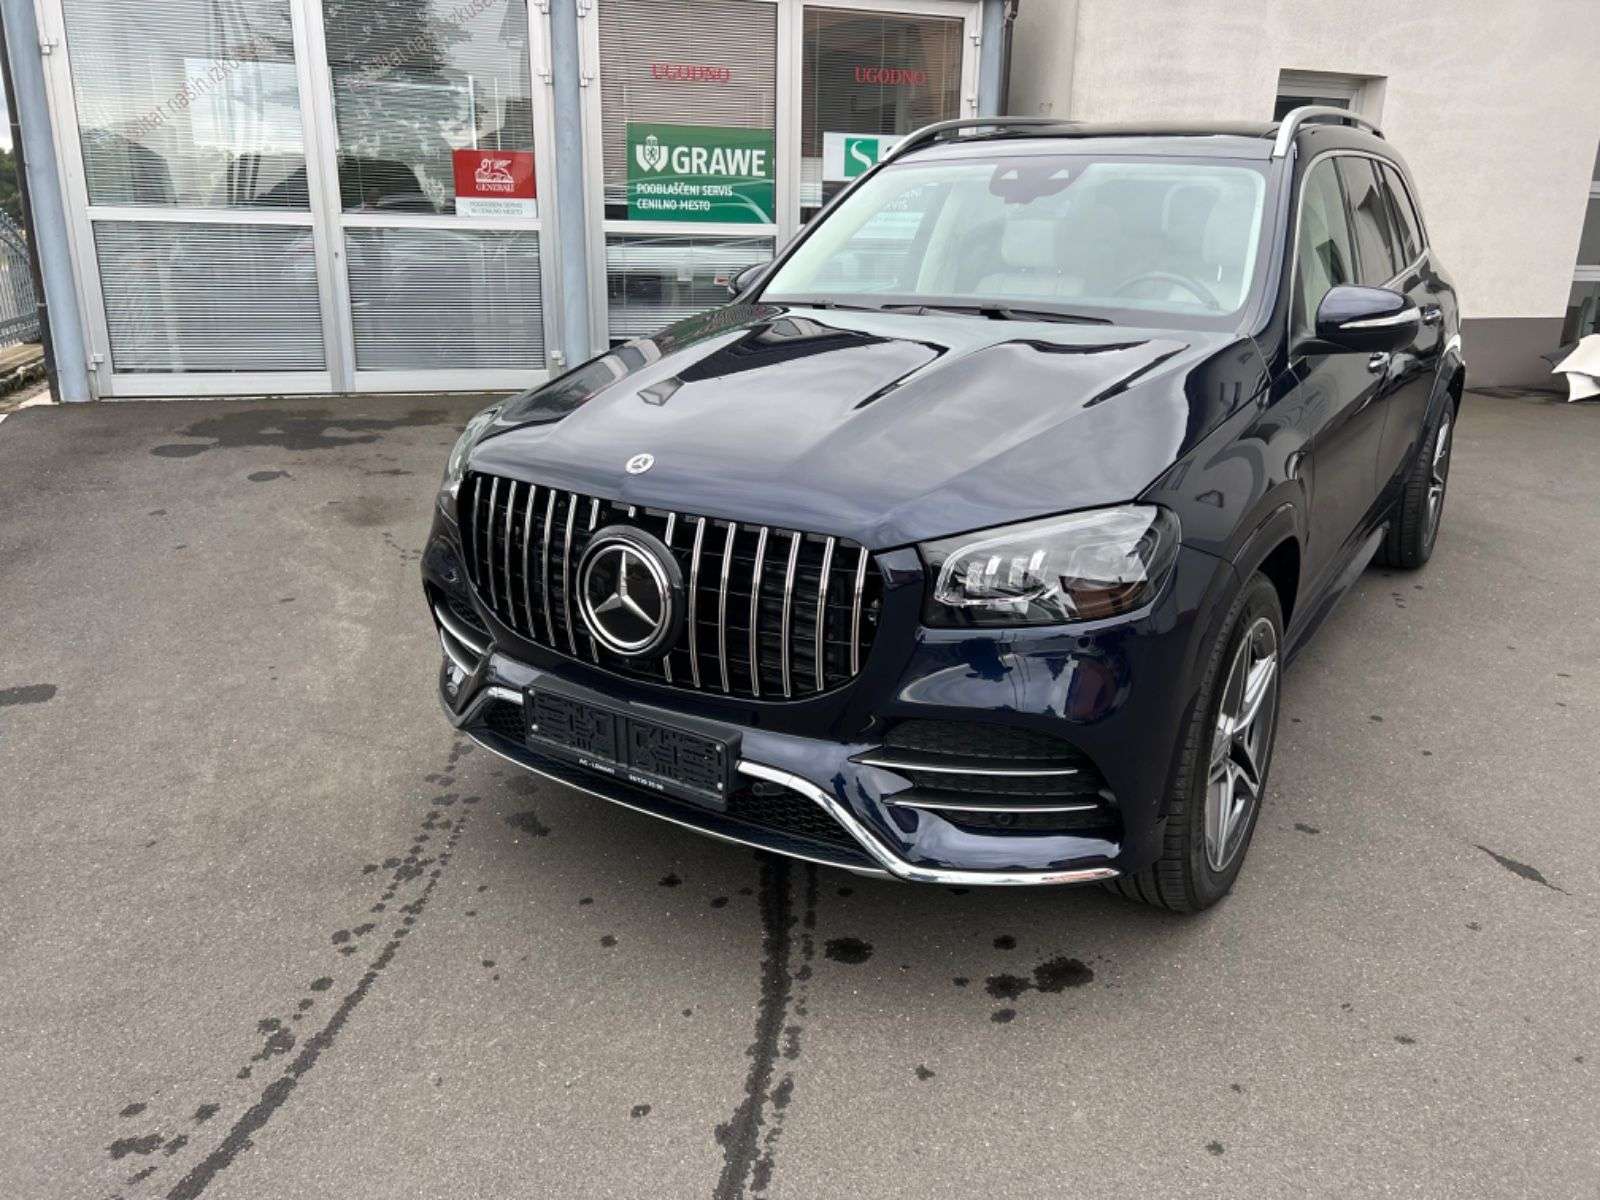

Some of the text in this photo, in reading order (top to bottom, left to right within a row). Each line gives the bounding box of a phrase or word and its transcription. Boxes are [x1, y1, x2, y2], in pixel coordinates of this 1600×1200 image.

[651, 64, 731, 85] UGODNO
[855, 64, 928, 86] UGODNO
[672, 146, 766, 176] GRAWE
[475, 183, 515, 192] GENERALI
[637, 182, 733, 196] POOBLAŠČENI SERVIS
[637, 198, 710, 211] CENILNO MESTO
